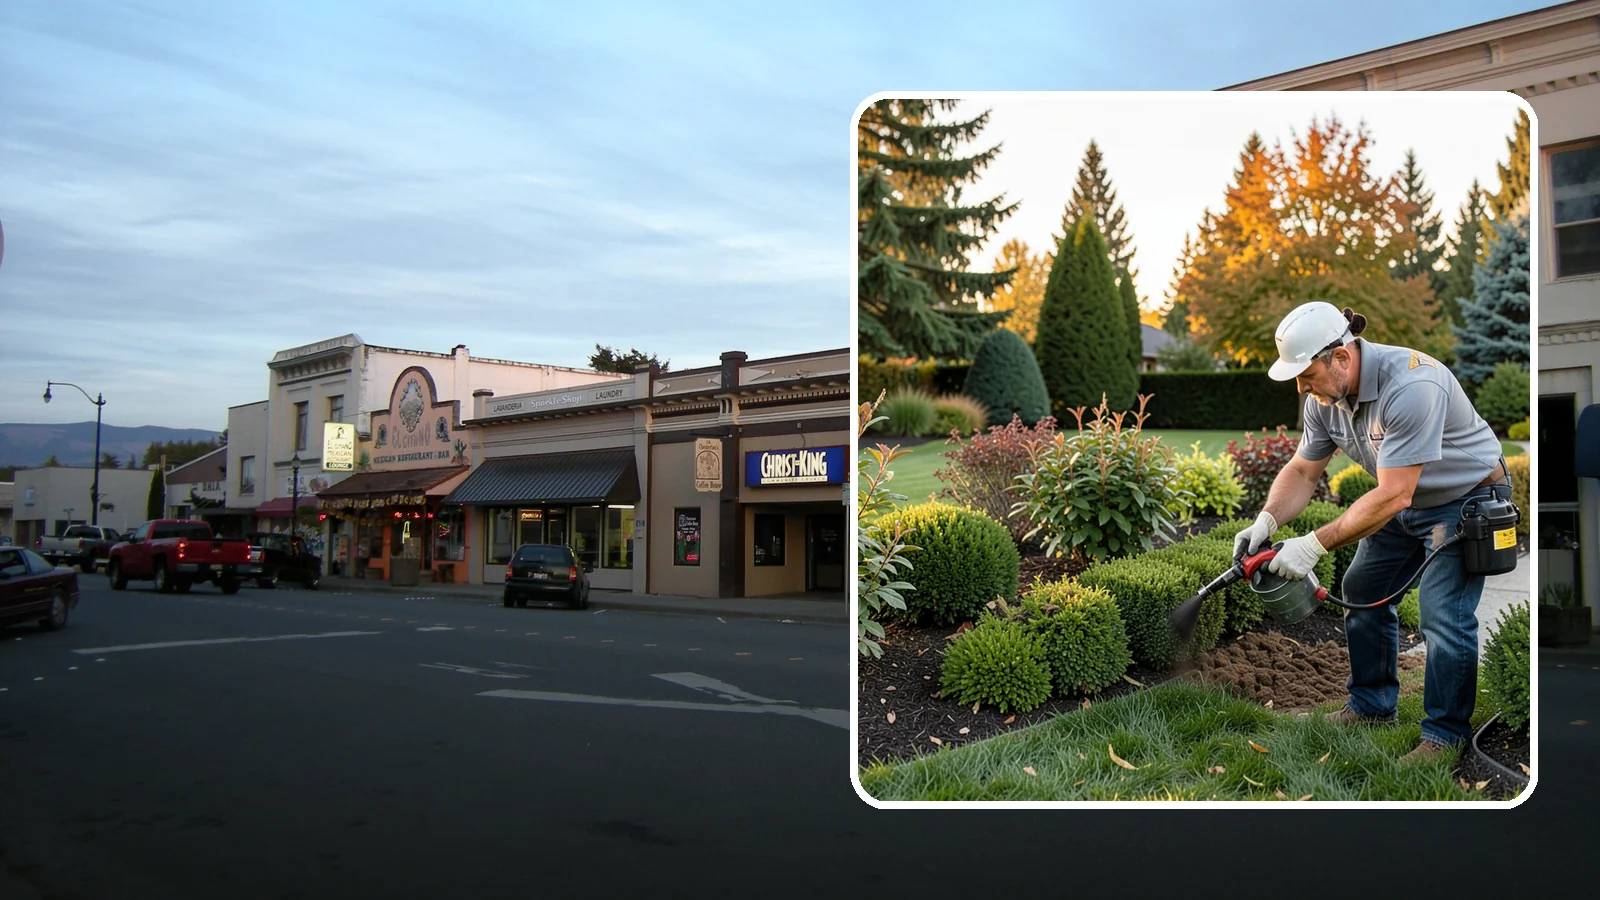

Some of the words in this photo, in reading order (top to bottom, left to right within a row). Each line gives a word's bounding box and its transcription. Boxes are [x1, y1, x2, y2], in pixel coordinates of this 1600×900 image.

[493, 402, 523, 413] LAVANDERIA
[595, 389, 624, 400] LAUNDRY
[373, 454, 396, 464] MEXICAN
[397, 451, 433, 462] RESTAURANT
[438, 450, 450, 459] BAR
[760, 452, 797, 478] CHRIST
[799, 450, 827, 476] KING
